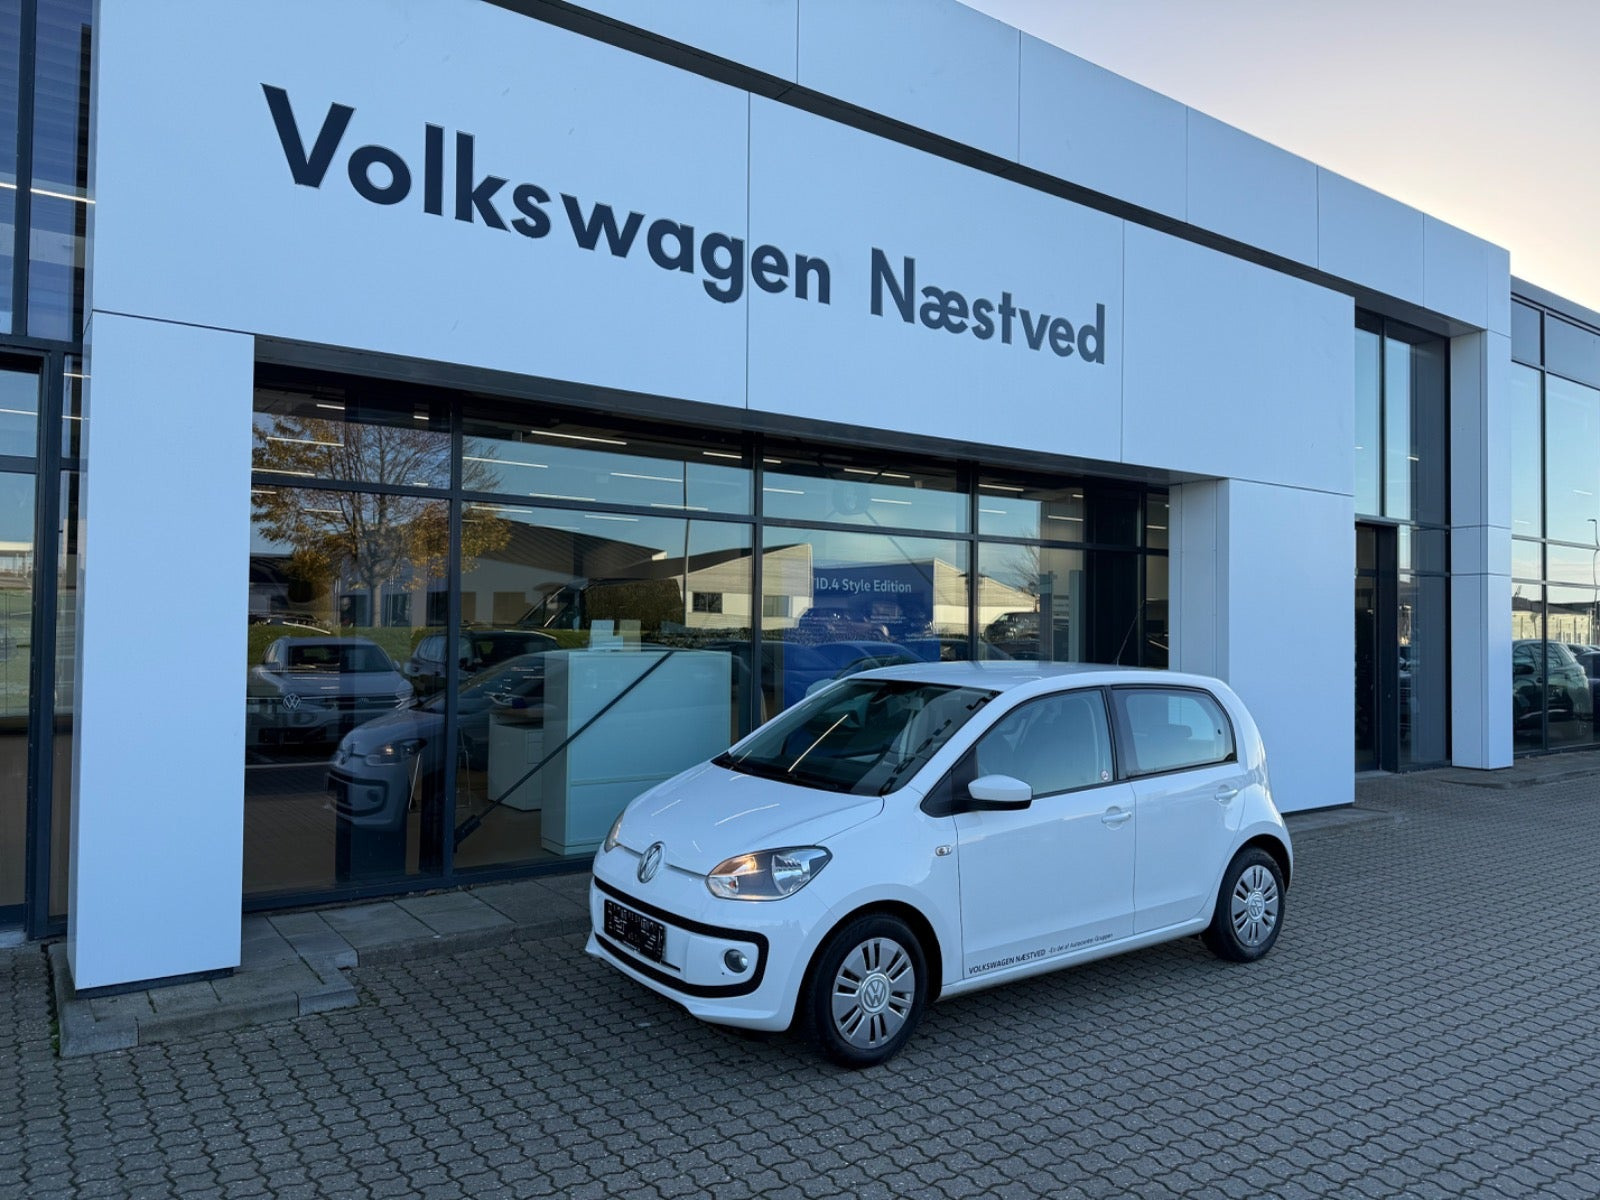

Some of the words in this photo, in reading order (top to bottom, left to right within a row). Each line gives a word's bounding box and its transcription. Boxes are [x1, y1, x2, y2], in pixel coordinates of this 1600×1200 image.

[260, 82, 831, 305] Volkswagen
[870, 246, 1105, 365] Næstved
[815, 577, 840, 591] ID.4
[842, 578, 871, 594] Style
[873, 579, 912, 593] Edition
[968, 957, 1015, 975] VOLKSWAGEN
[1015, 949, 1046, 963] NÆSTVED
[863, 977, 887, 1009] VW
